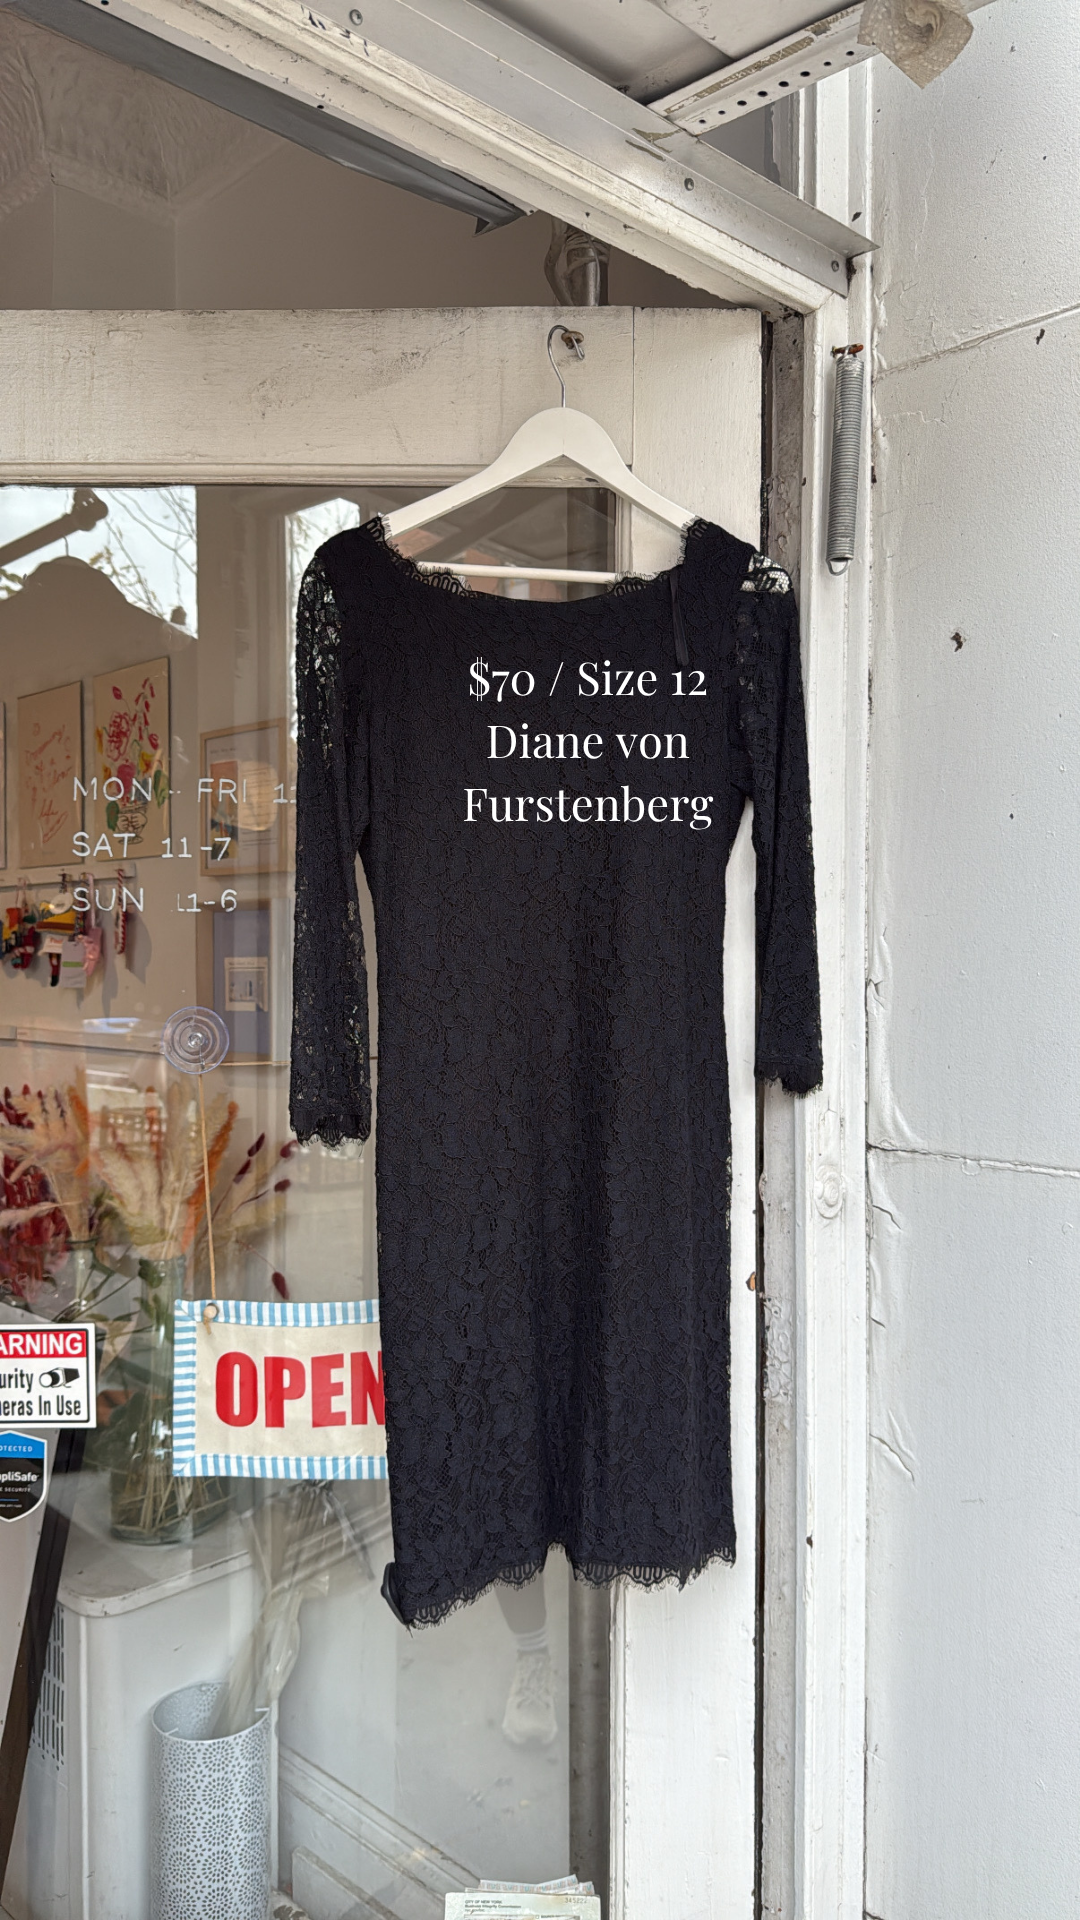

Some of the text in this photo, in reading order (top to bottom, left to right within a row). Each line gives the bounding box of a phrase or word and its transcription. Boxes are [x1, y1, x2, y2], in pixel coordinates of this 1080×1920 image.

[73, 777, 153, 801] MON
[197, 778, 248, 803] FRI
[72, 831, 136, 858] SAT
[72, 887, 145, 912] SUN
[215, 1351, 386, 1429] OPEN
[0, 1394, 81, 1417] eras In Use
